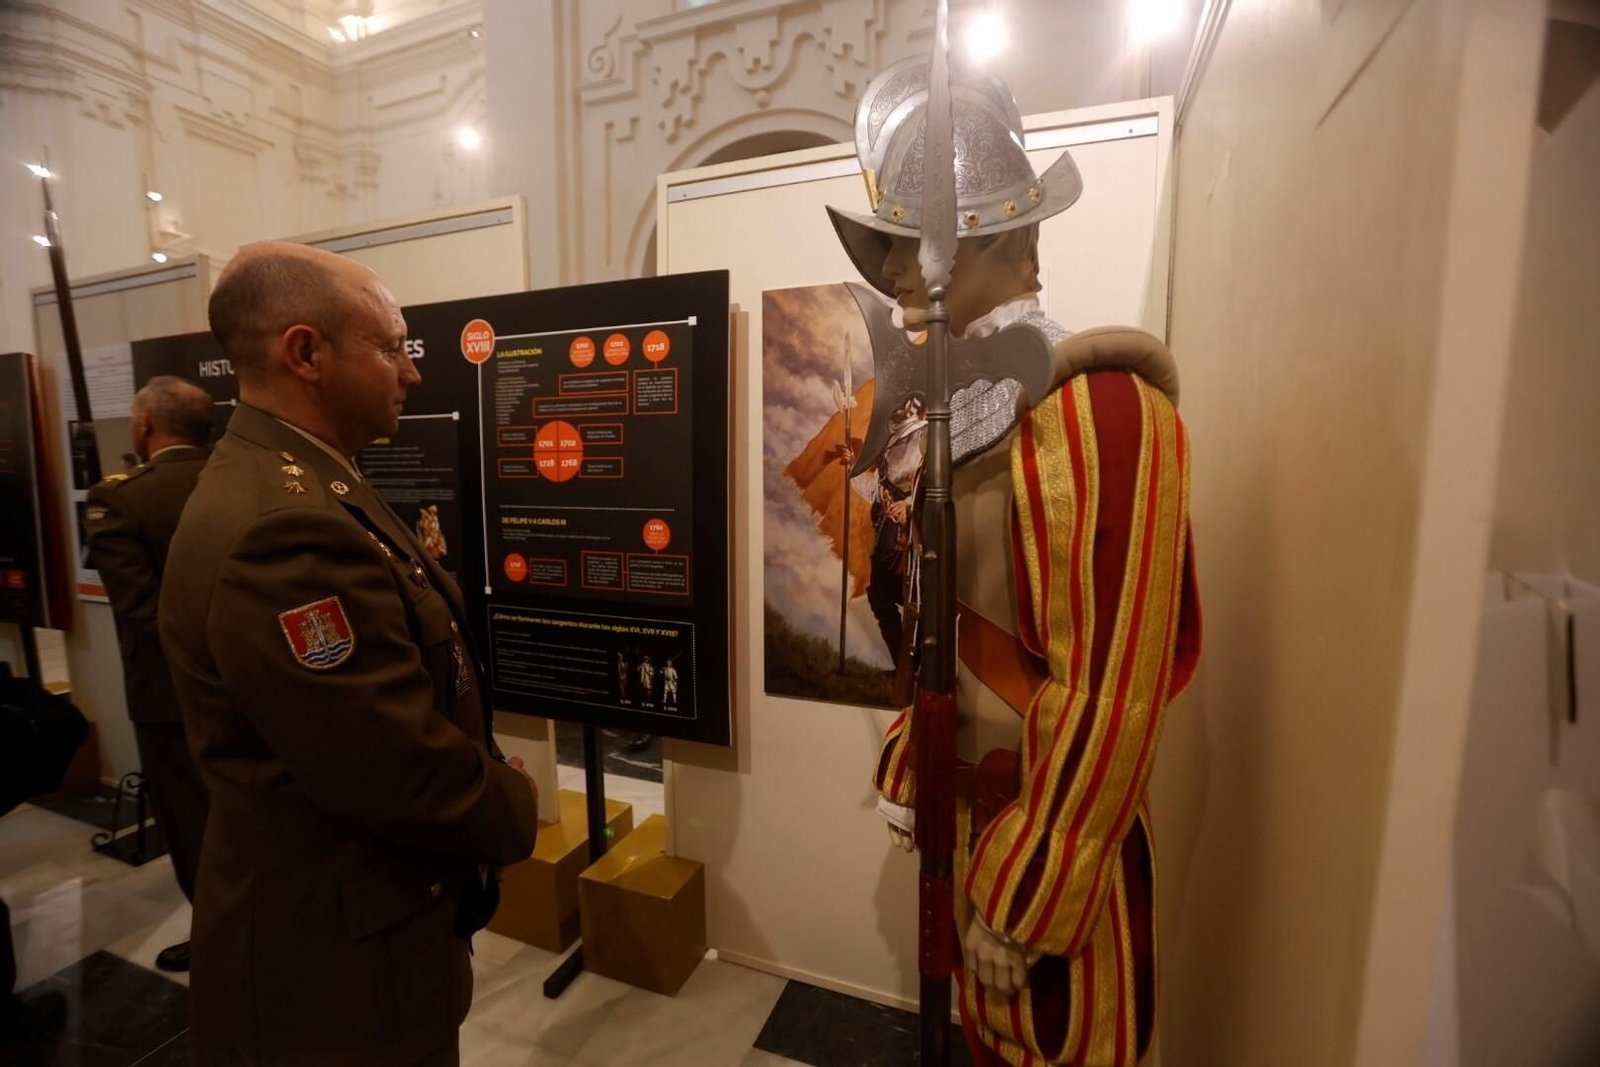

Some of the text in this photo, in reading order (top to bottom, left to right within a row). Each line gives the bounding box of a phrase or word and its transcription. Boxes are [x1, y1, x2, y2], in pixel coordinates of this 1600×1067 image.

[467, 331, 490, 341] SIGLO
[466, 341, 491, 354] XVIII
[647, 342, 665, 353] 1718
[496, 350, 504, 358] LA
[537, 518, 560, 526] CARLOS
